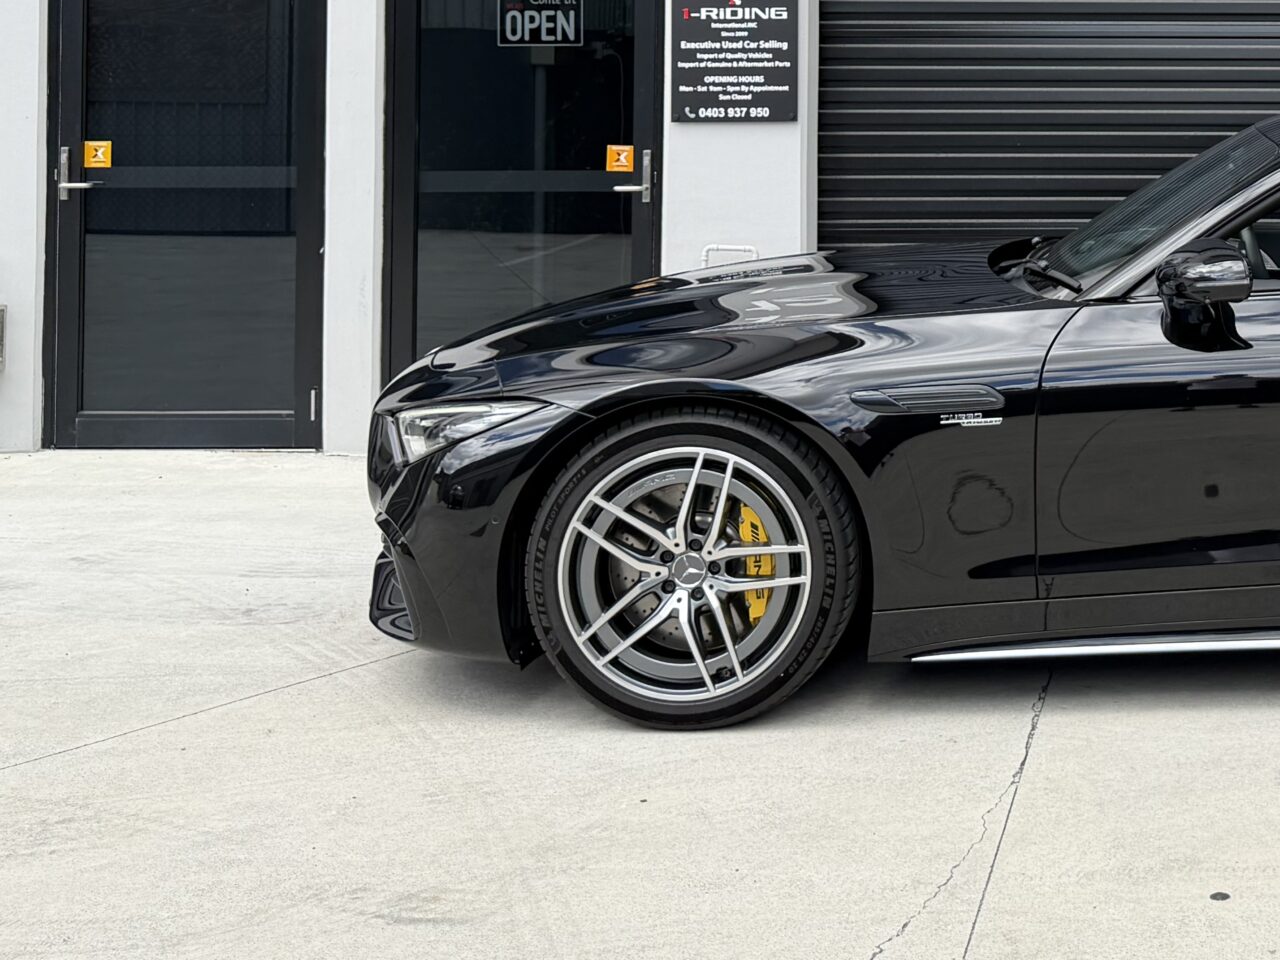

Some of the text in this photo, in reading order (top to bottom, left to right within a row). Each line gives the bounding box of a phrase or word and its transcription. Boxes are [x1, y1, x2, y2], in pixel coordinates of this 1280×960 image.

[505, 9, 576, 42] OPEN
[680, 40, 788, 51] Executive Used Car Selling
[696, 52, 718, 60] Import
[718, 52, 726, 60] of
[725, 52, 748, 60] Quality
[677, 61, 698, 69] Import
[699, 60, 707, 68] of
[706, 60, 732, 68] Genuine
[738, 60, 774, 68] Aftermarket
[774, 60, 791, 68] Parts
[704, 75, 765, 83] OPENING HOURS
[740, 85, 749, 93] By
[749, 85, 789, 93] Appointment
[698, 107, 770, 118] 0403 937 950
[817, 518, 836, 610] MICHELIN
[534, 539, 551, 629] MICHELIN
